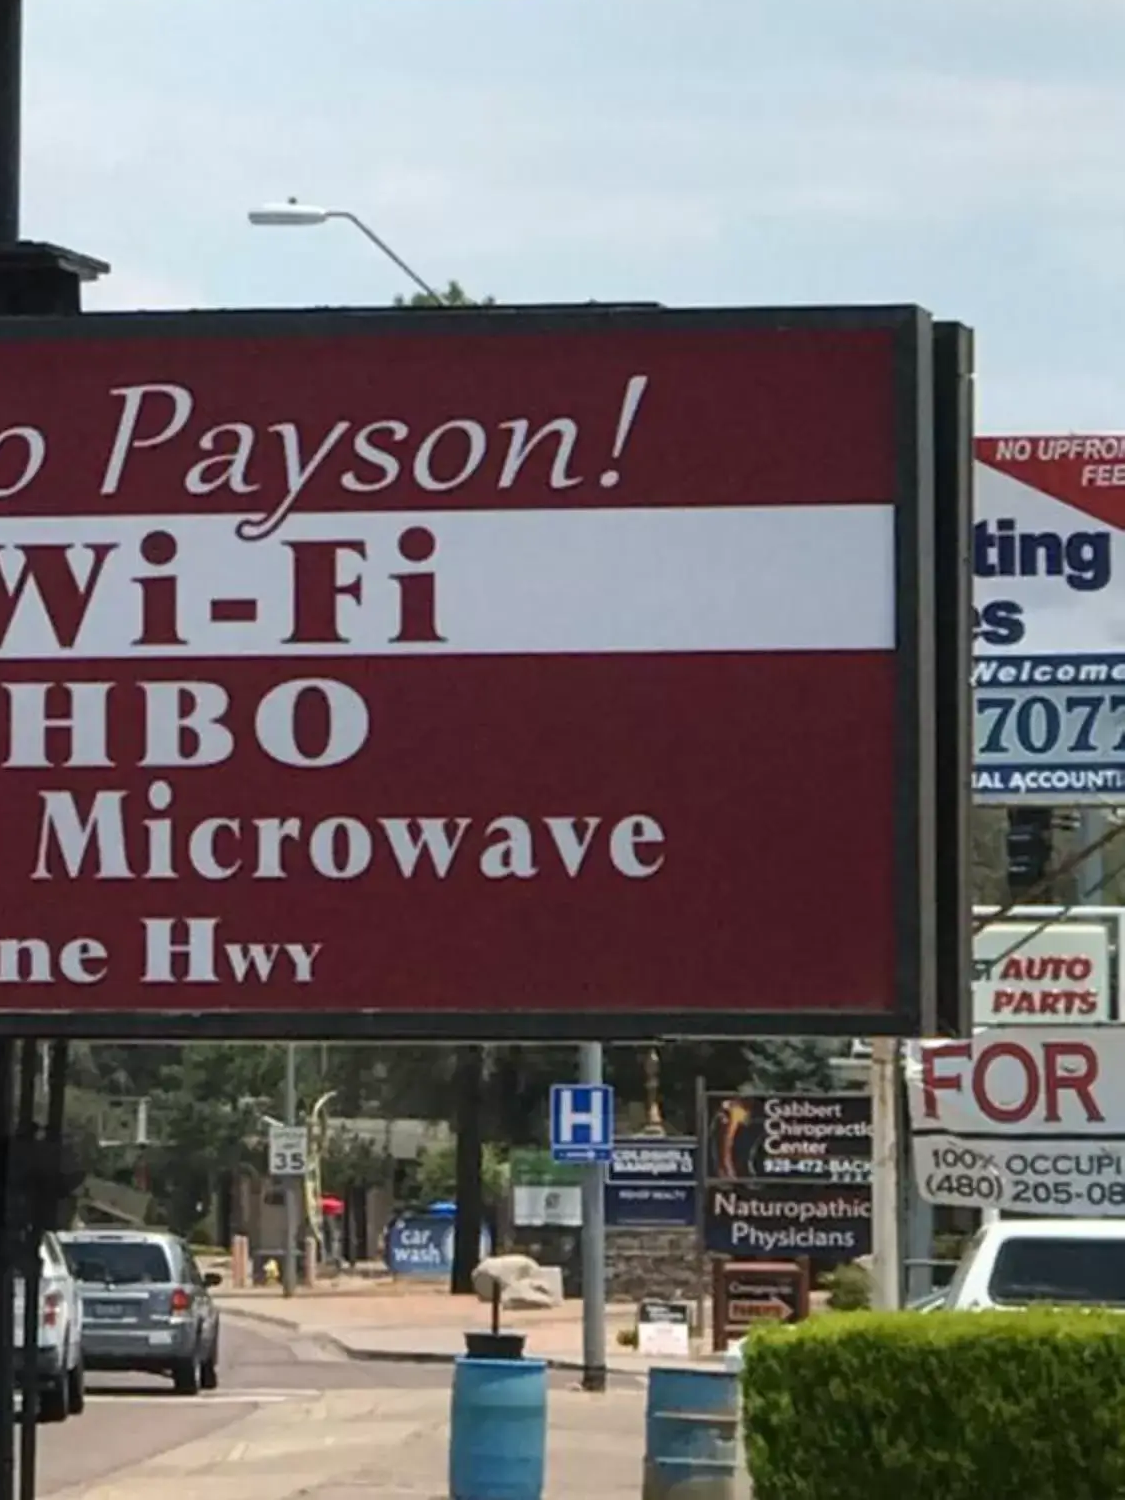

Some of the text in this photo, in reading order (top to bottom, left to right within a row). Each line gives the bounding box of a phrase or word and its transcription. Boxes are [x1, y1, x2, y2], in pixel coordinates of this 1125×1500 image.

[100, 375, 648, 538] Payson!
[995, 440, 1032, 461] NO
[972, 518, 1111, 592] ting
[31, 780, 665, 881] Microwave
[1000, 956, 1092, 982] AUTO
[993, 990, 1097, 1015] PARTS
[921, 1041, 1106, 1124] FOR
[559, 1089, 603, 1143] H
[764, 1100, 842, 1118] Gabbert
[764, 1135, 827, 1155] Center
[275, 1152, 305, 1171] 35
[932, 1149, 999, 1170] 100%
[926, 1173, 1004, 1201] (480)
[714, 1193, 872, 1221] Naturopathic
[400, 1229, 431, 1246] car
[732, 1222, 855, 1251] Physicians
[394, 1242, 441, 1264] wash
